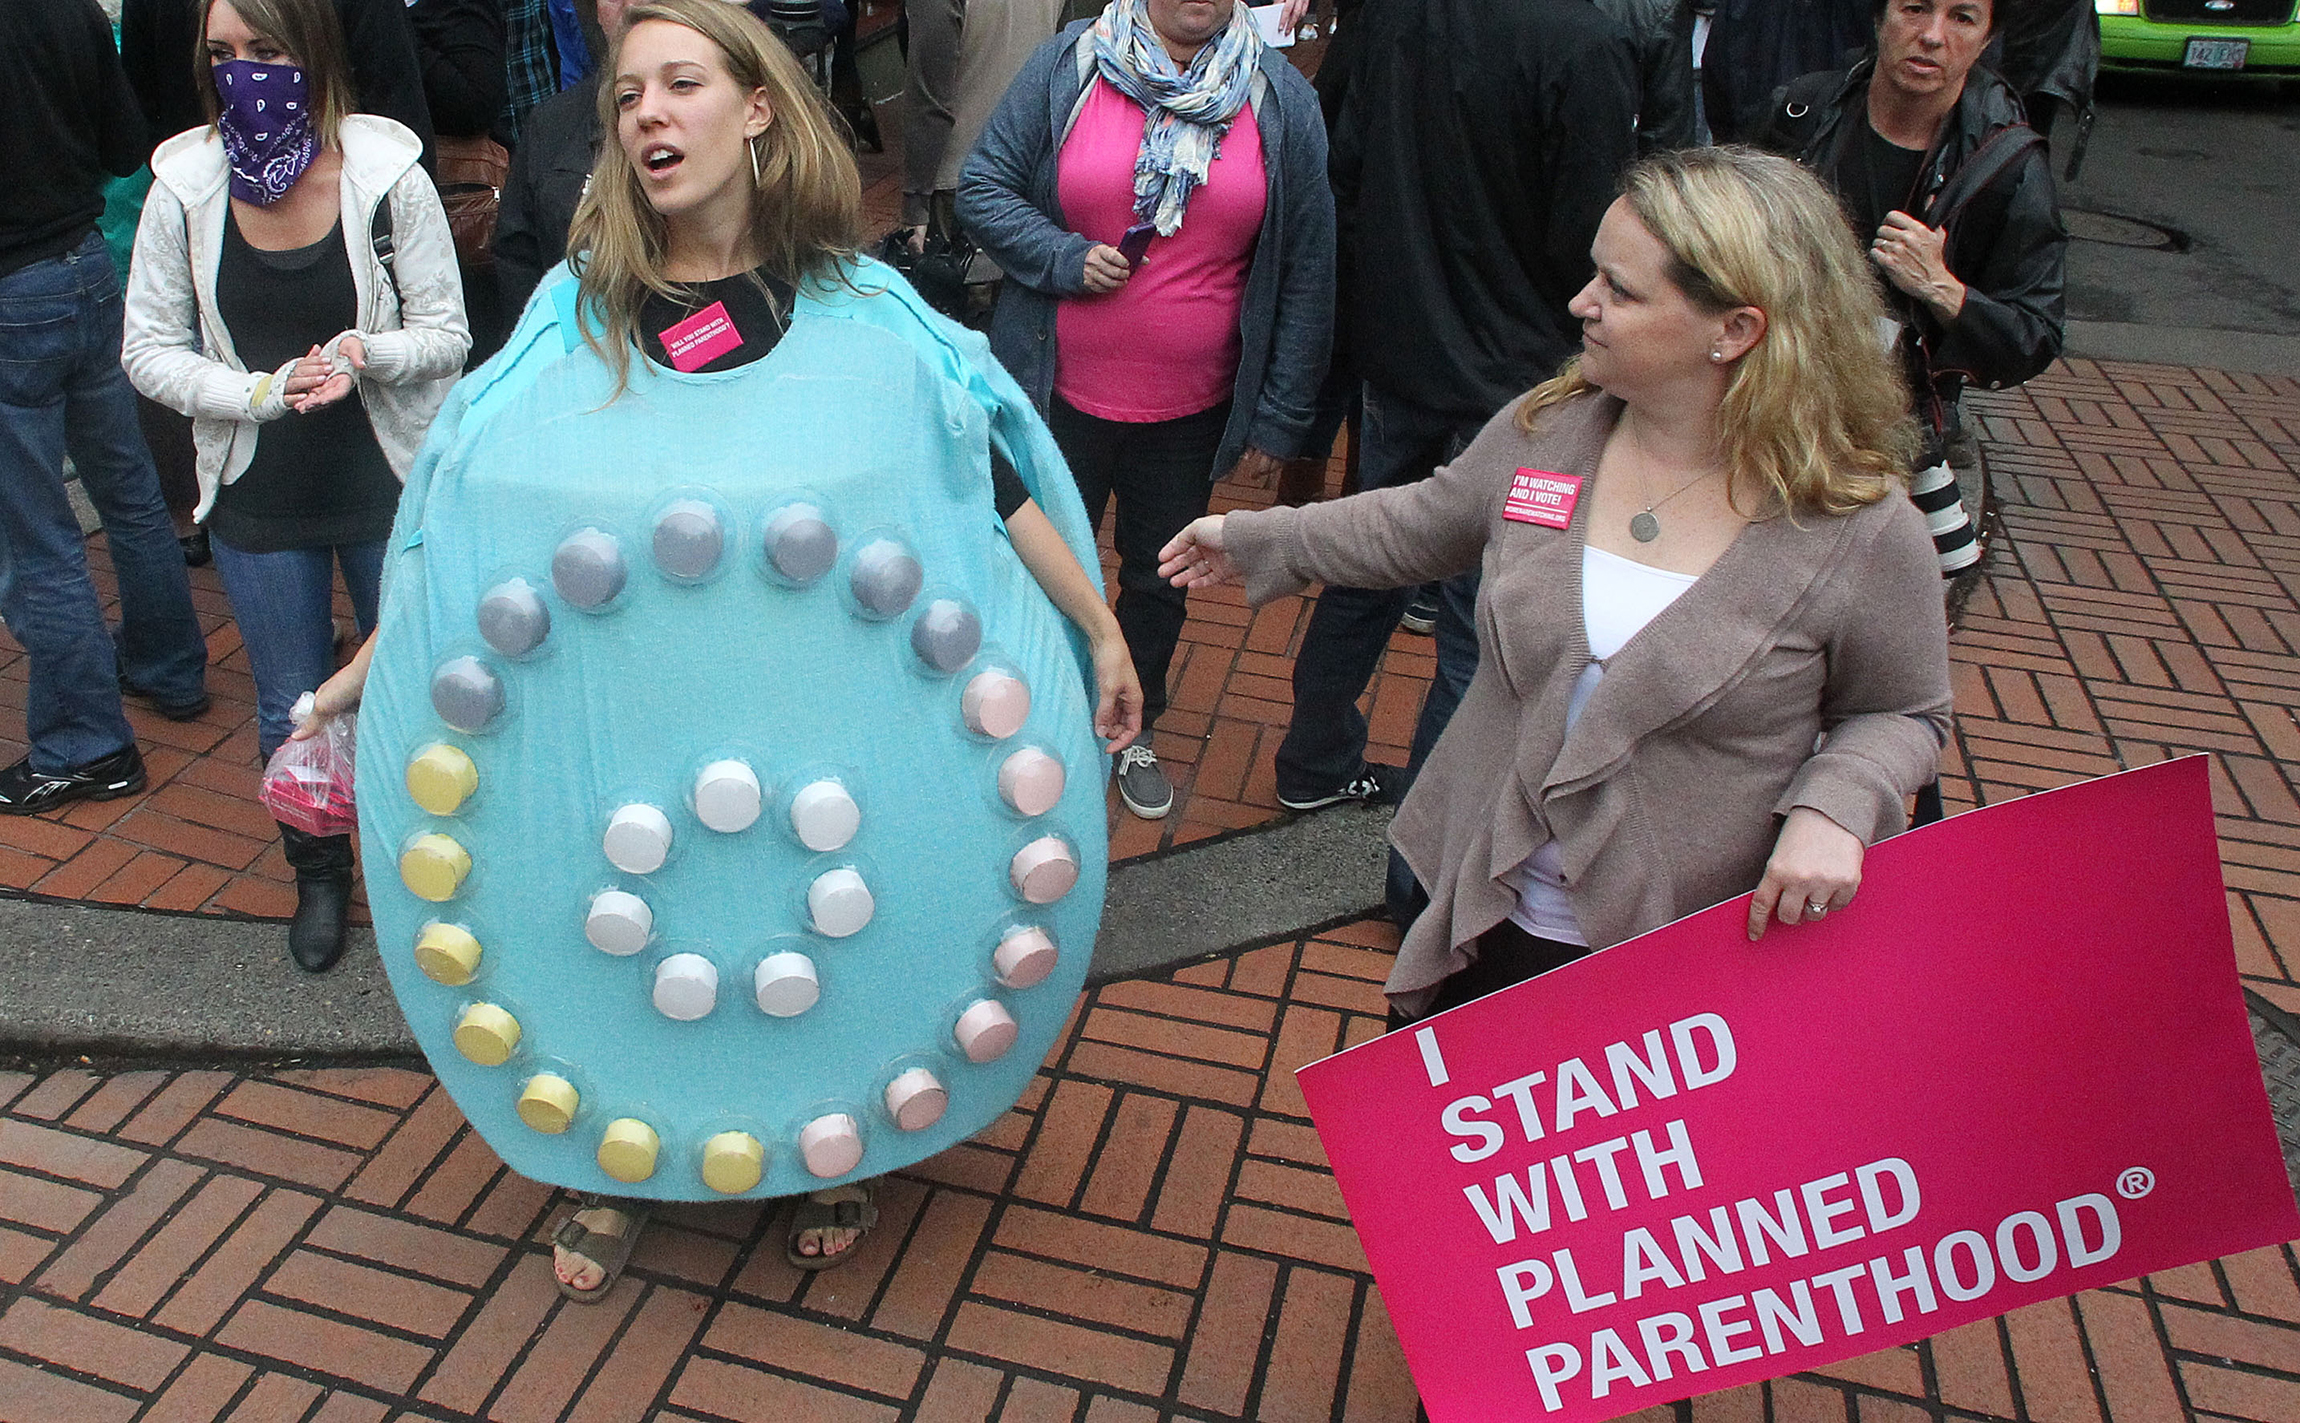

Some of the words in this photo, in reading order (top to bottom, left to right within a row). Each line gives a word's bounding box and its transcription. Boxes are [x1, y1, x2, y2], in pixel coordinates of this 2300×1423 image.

[670, 339, 685, 349] WILL
[683, 332, 695, 343] YOU
[693, 324, 711, 337] STAND
[709, 317, 725, 328] WITH
[671, 341, 695, 358] PLANNED
[1509, 487, 1529, 499] AND
[1530, 490, 1536, 501] I
[1535, 490, 1562, 505] VOTE!
[1513, 474, 1529, 487] I'M
[1529, 477, 1576, 495] WATCHING
[1415, 1025, 1450, 1087] I
[1441, 1012, 1737, 1163] STAND
[1463, 1118, 1704, 1245] WITH
[1495, 1157, 1921, 1330] PLANNED
